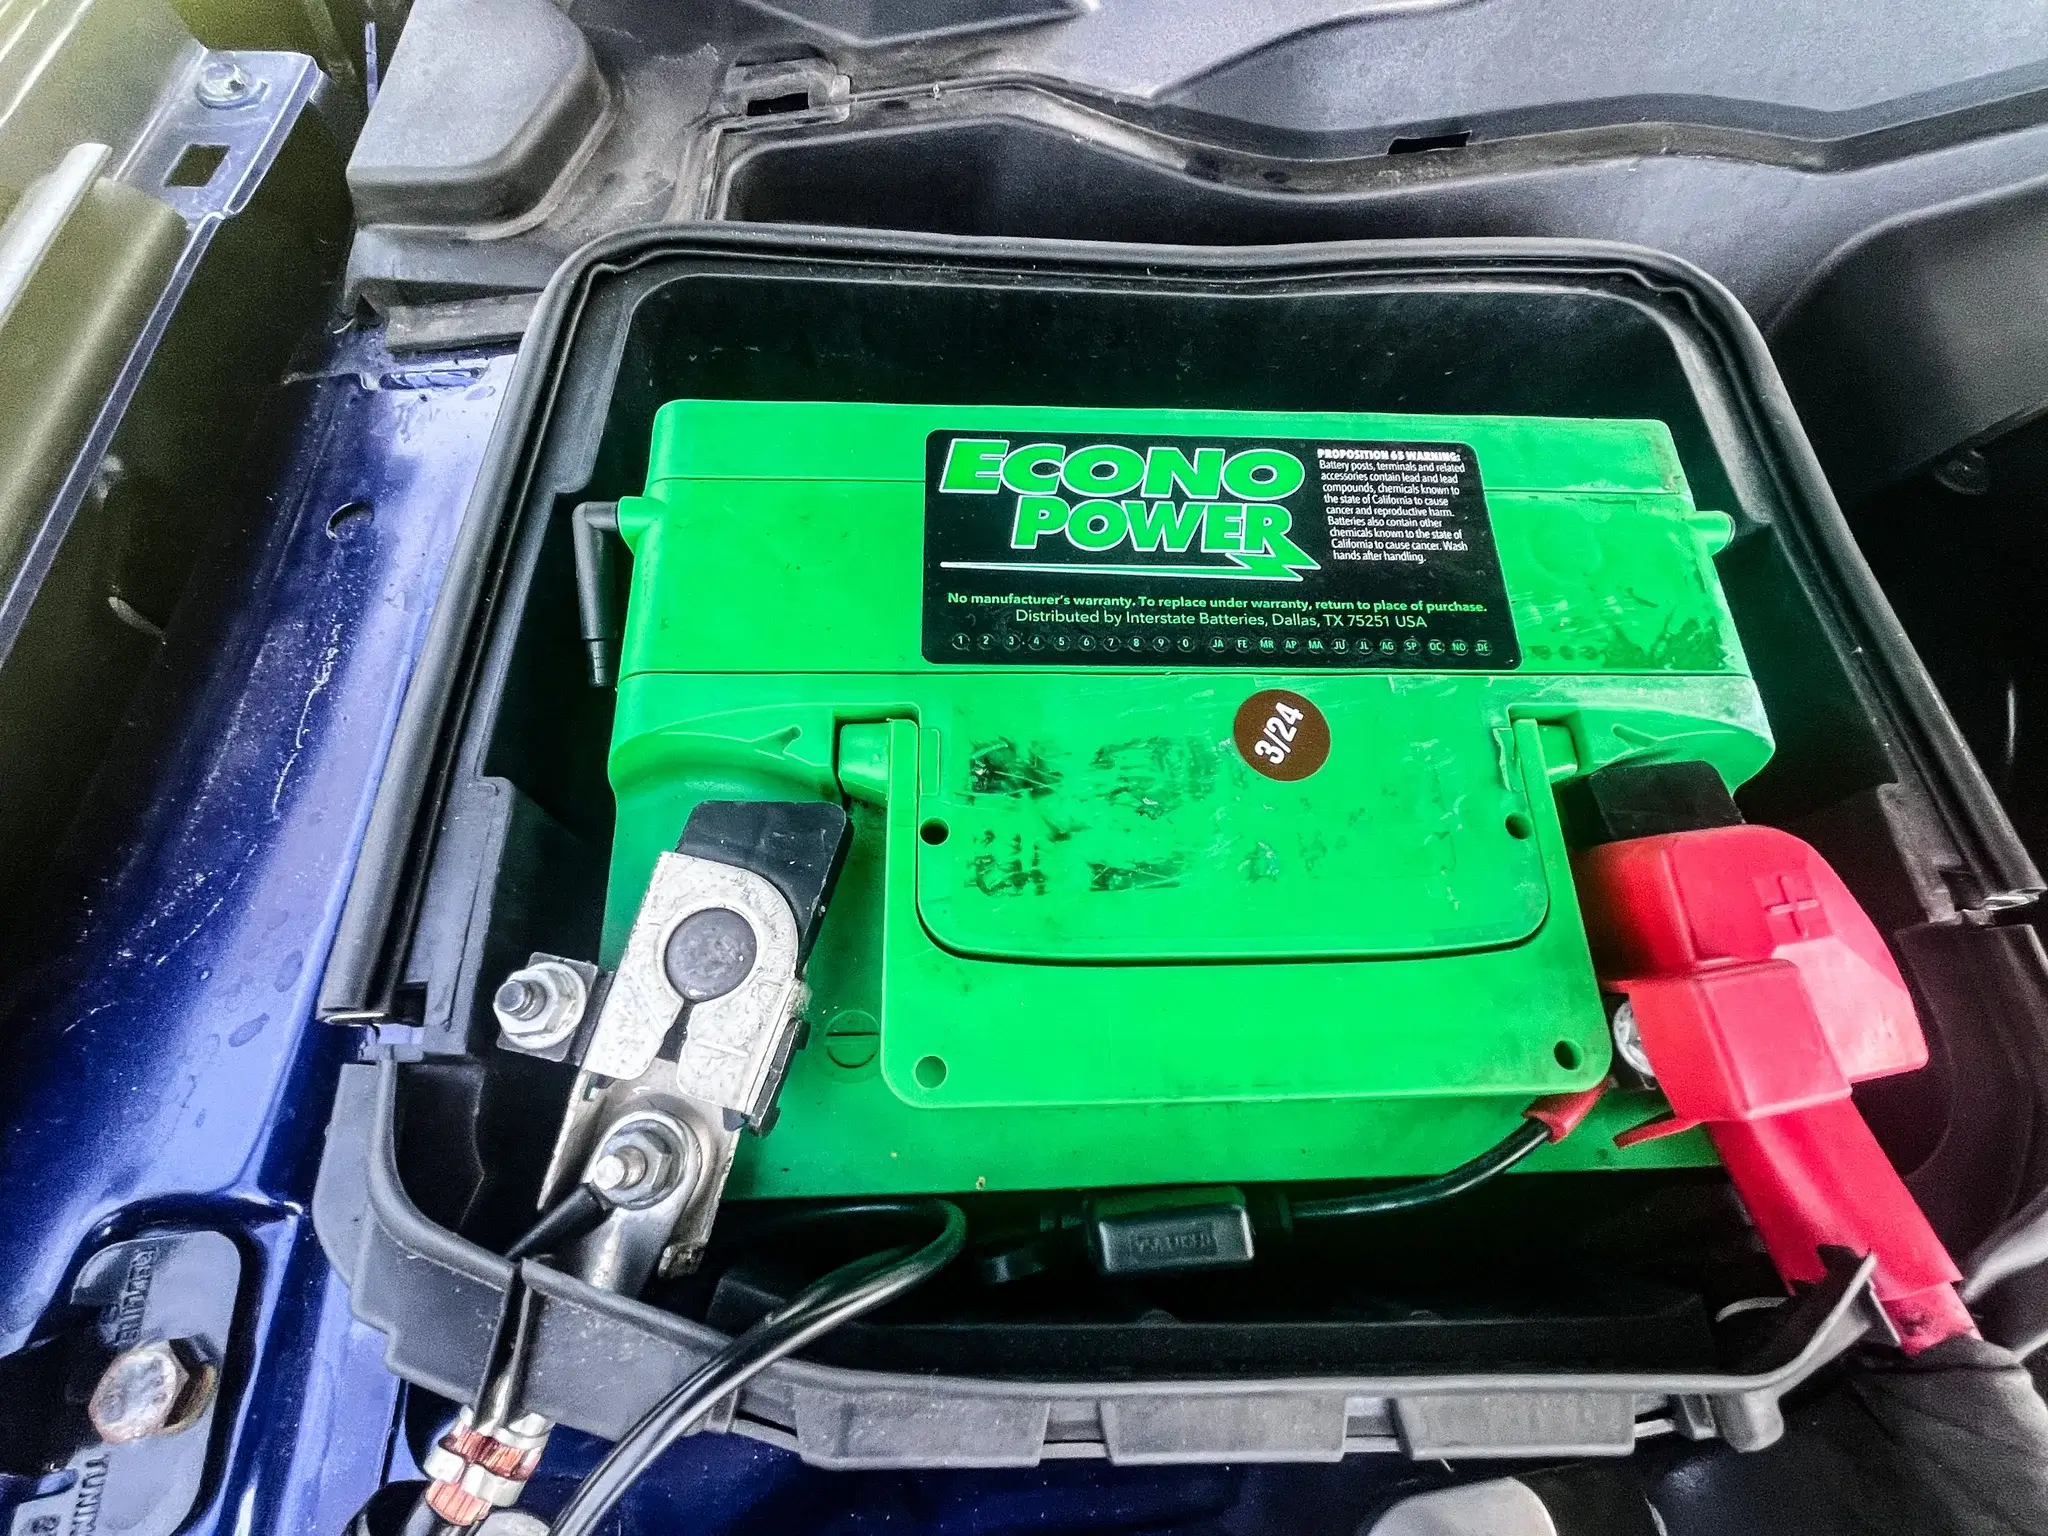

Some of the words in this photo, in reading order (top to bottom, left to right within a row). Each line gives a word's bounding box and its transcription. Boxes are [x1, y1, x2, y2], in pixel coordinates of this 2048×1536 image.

[1317, 449, 1389, 460] PROPOSITION
[1390, 451, 1404, 460] 65
[1405, 451, 1461, 461] WARNING:
[939, 438, 1306, 499] ECONO
[1319, 460, 1349, 471] Battery
[1350, 461, 1375, 471] posts,
[1377, 462, 1416, 472] terminals
[1418, 463, 1435, 472] and
[1436, 463, 1465, 472] related
[1321, 472, 1368, 481] accessories
[1370, 473, 1401, 481] contain
[1402, 474, 1420, 482] lead
[1422, 474, 1438, 483] and
[1440, 474, 1458, 483] lead
[1323, 483, 1376, 494] compounds,
[1378, 484, 1420, 494] chemicals
[1421, 484, 1449, 494] known
[1450, 486, 1459, 495] to
[1324, 494, 1339, 503] the
[1340, 495, 1360, 504] state
[1362, 494, 1371, 504] of
[1372, 495, 1412, 505] California
[1413, 496, 1423, 505] to
[1425, 497, 1449, 506] cause
[1326, 506, 1354, 515] cancer
[1356, 506, 1372, 515] and
[1374, 506, 1427, 517] reproductive
[1429, 507, 1454, 517] harm.
[1010, 495, 1293, 556] POWER
[1328, 516, 1366, 526] Batteries
[1368, 517, 1384, 526] also
[1386, 518, 1418, 527] contain
[1420, 518, 1442, 527] other
[1330, 527, 1373, 538] chemicals
[1374, 528, 1403, 538] known
[1405, 529, 1414, 538] to
[1415, 529, 1430, 539] the
[1431, 530, 1452, 539] state
[1454, 529, 1463, 539] of
[1331, 538, 1373, 549] California
[1375, 540, 1384, 549] to
[1385, 541, 1410, 550] cause
[1411, 542, 1442, 550] cancer.
[1443, 541, 1468, 551] Wash
[1333, 550, 1361, 560] hands
[1362, 550, 1382, 560] after
[1384, 551, 1426, 564] handling.
[948, 593, 968, 604] No
[1073, 596, 1136, 608] warranty.
[1138, 596, 1156, 607] To
[1158, 597, 1206, 609] replace
[1210, 598, 1248, 609] under
[1251, 599, 1312, 611] warranty,
[1315, 600, 1355, 611] return
[1357, 600, 1371, 611] to
[1373, 600, 1408, 613] place
[1410, 600, 1423, 611] of
[1426, 601, 1487, 613] purchase.
[1016, 609, 1099, 623] Distributed
[1103, 610, 1122, 627] by
[1126, 611, 1195, 624] Interstate
[1200, 612, 1268, 627] Batteries,
[1273, 613, 1320, 627] Dallas,
[1323, 614, 1344, 627] TX
[1348, 614, 1390, 627] 75251
[1395, 615, 1427, 628] USA
[1254, 702, 1304, 765] 3/24
